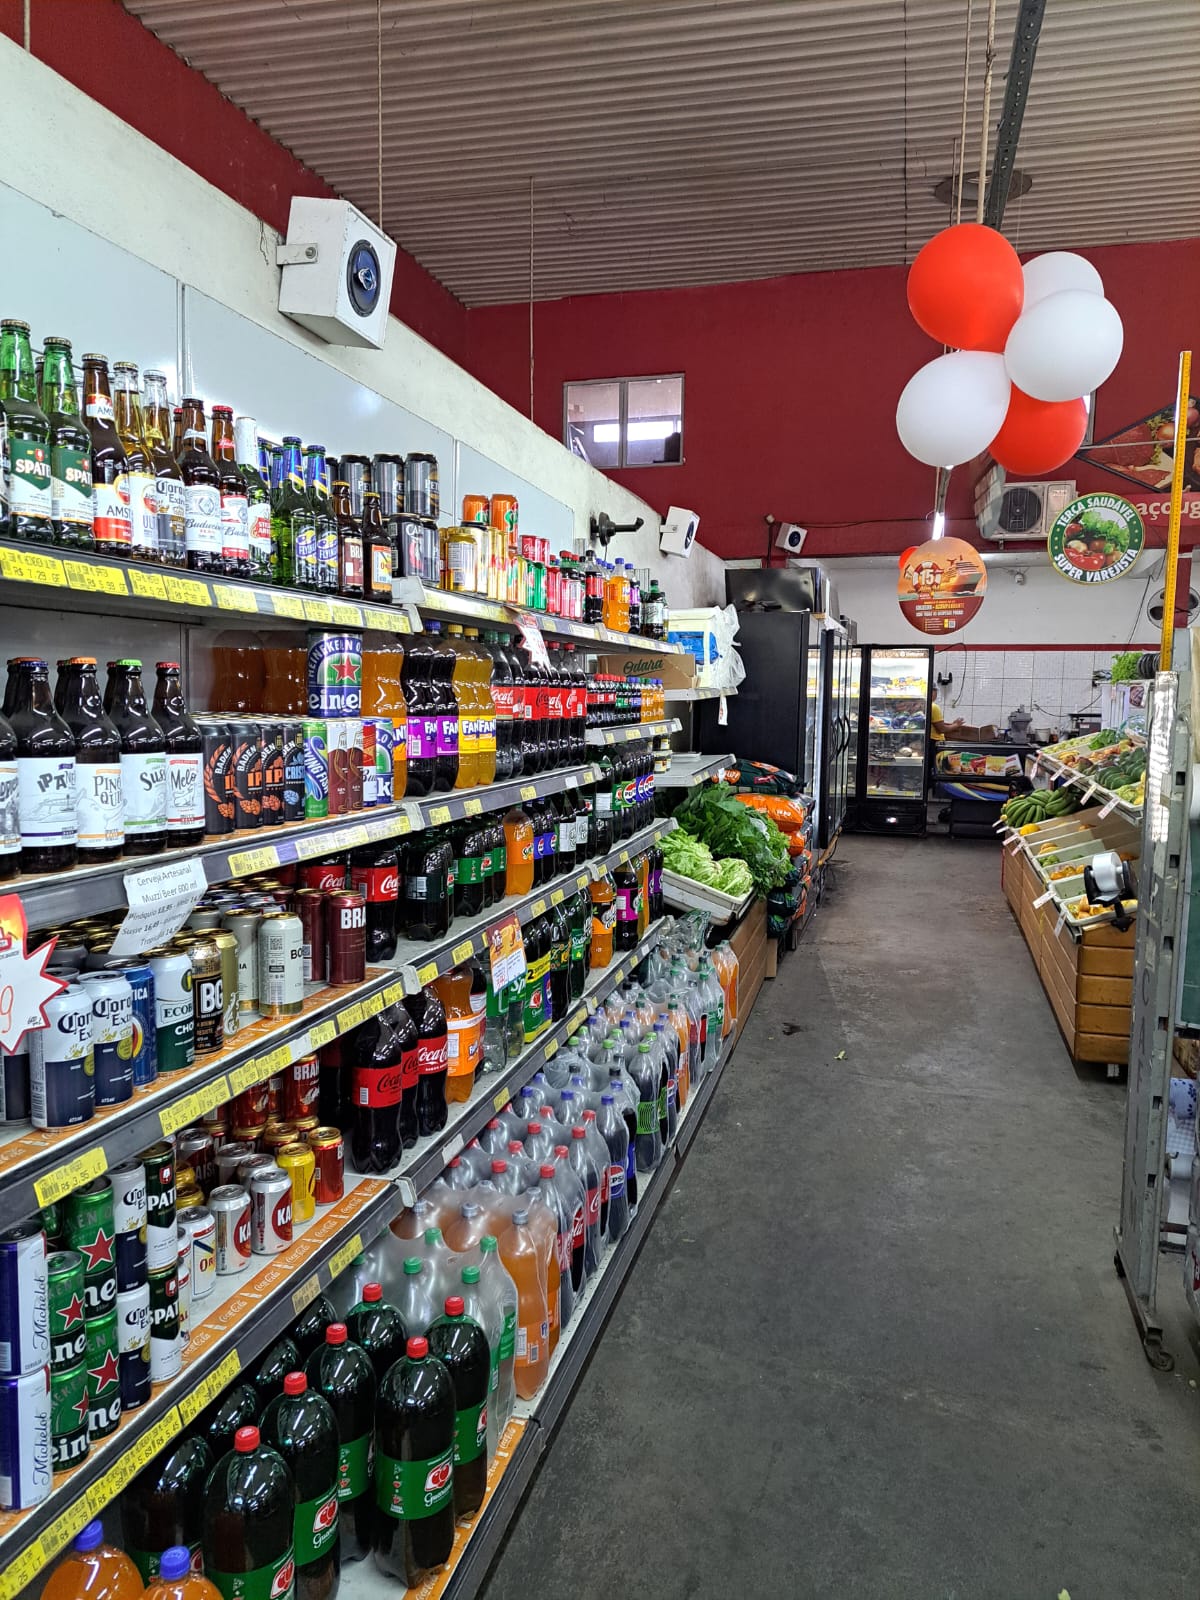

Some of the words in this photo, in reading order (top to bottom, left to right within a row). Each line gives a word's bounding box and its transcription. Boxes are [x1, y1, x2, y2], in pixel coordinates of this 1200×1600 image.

[1087, 497, 1136, 522] SAUDÁVEL
[1054, 553, 1083, 581] SUPER
[1086, 548, 1138, 582] VAREJISTA
[920, 569, 933, 585] 15
[623, 658, 664, 676] Odara
[214, 746, 232, 775] BADEN
[236, 744, 256, 773] BADEN
[161, 864, 192, 880] Artesanal
[141, 891, 162, 903] Muzzi
[161, 887, 177, 899] Beer
[527, 969, 534, 980] 2
[60, 1183, 70, 1193] R$
[32, 1275, 48, 1351] Michelob
[32, 1411, 48, 1487] Michelob
[97, 1493, 107, 1505] R$
[59, 1529, 70, 1543] R$
